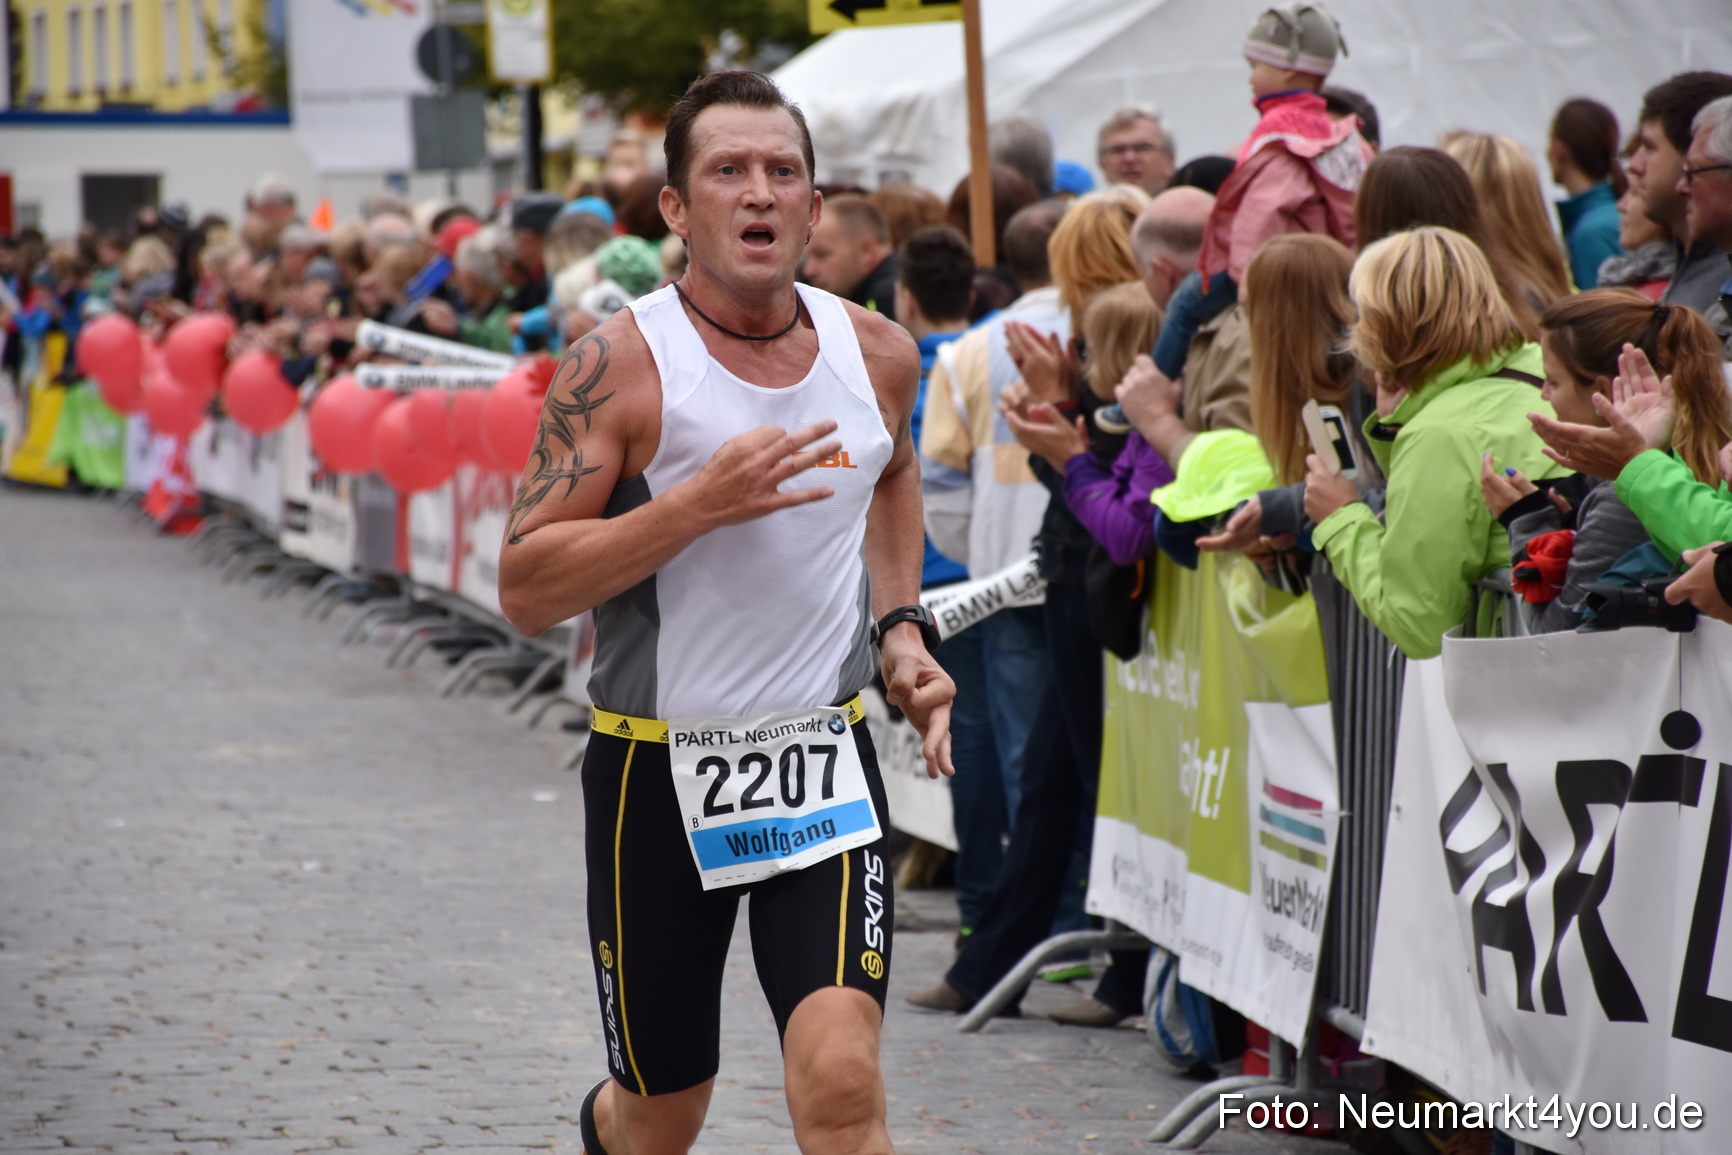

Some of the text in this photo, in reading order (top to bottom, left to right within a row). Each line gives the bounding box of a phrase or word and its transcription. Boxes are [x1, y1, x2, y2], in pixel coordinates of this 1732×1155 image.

[941, 572, 1041, 632] BMW La
[613, 728, 634, 738] adidas
[675, 718, 822, 748] PARTL Neumarkt
[696, 743, 838, 818] 2207
[691, 817, 700, 829] B
[725, 818, 836, 857] Wolfgang
